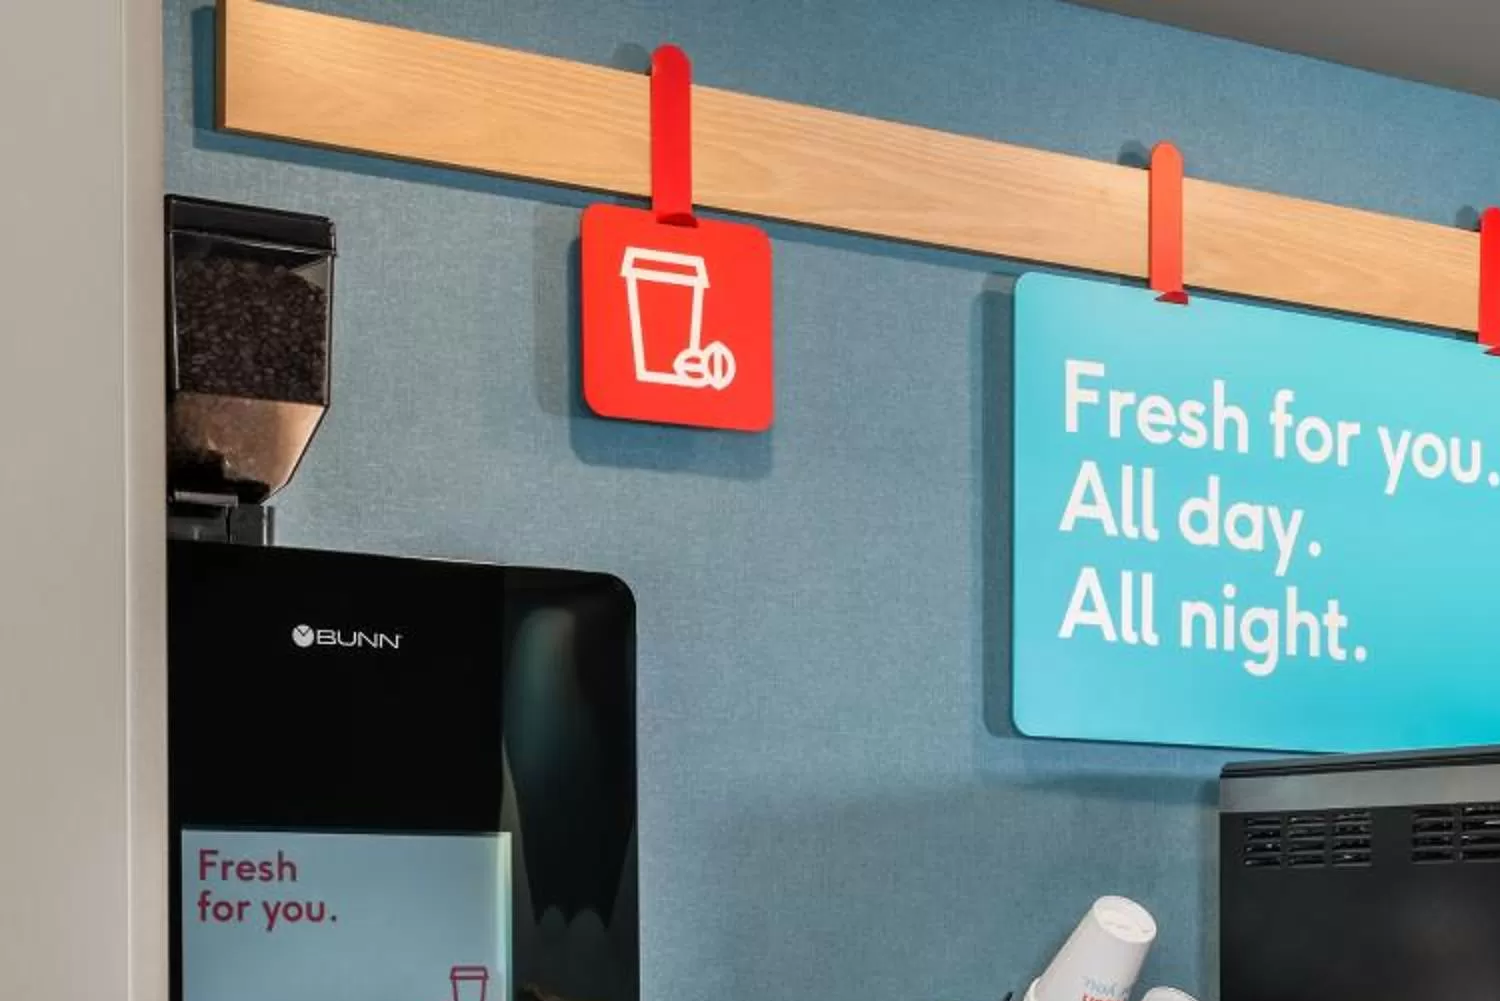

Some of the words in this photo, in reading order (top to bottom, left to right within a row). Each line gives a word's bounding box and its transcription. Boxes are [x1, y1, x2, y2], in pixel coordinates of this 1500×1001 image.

[1064, 358, 1249, 454] Fresh
[1269, 390, 1361, 467] for
[1377, 425, 1500, 496] you.
[1058, 460, 1160, 541] All
[1178, 474, 1322, 577] day.
[317, 629, 400, 649] BUNN
[1058, 566, 1160, 647] All
[1180, 584, 1368, 677] night.
[199, 849, 298, 882] Fresh
[197, 889, 251, 922] for
[261, 901, 337, 933] you.
